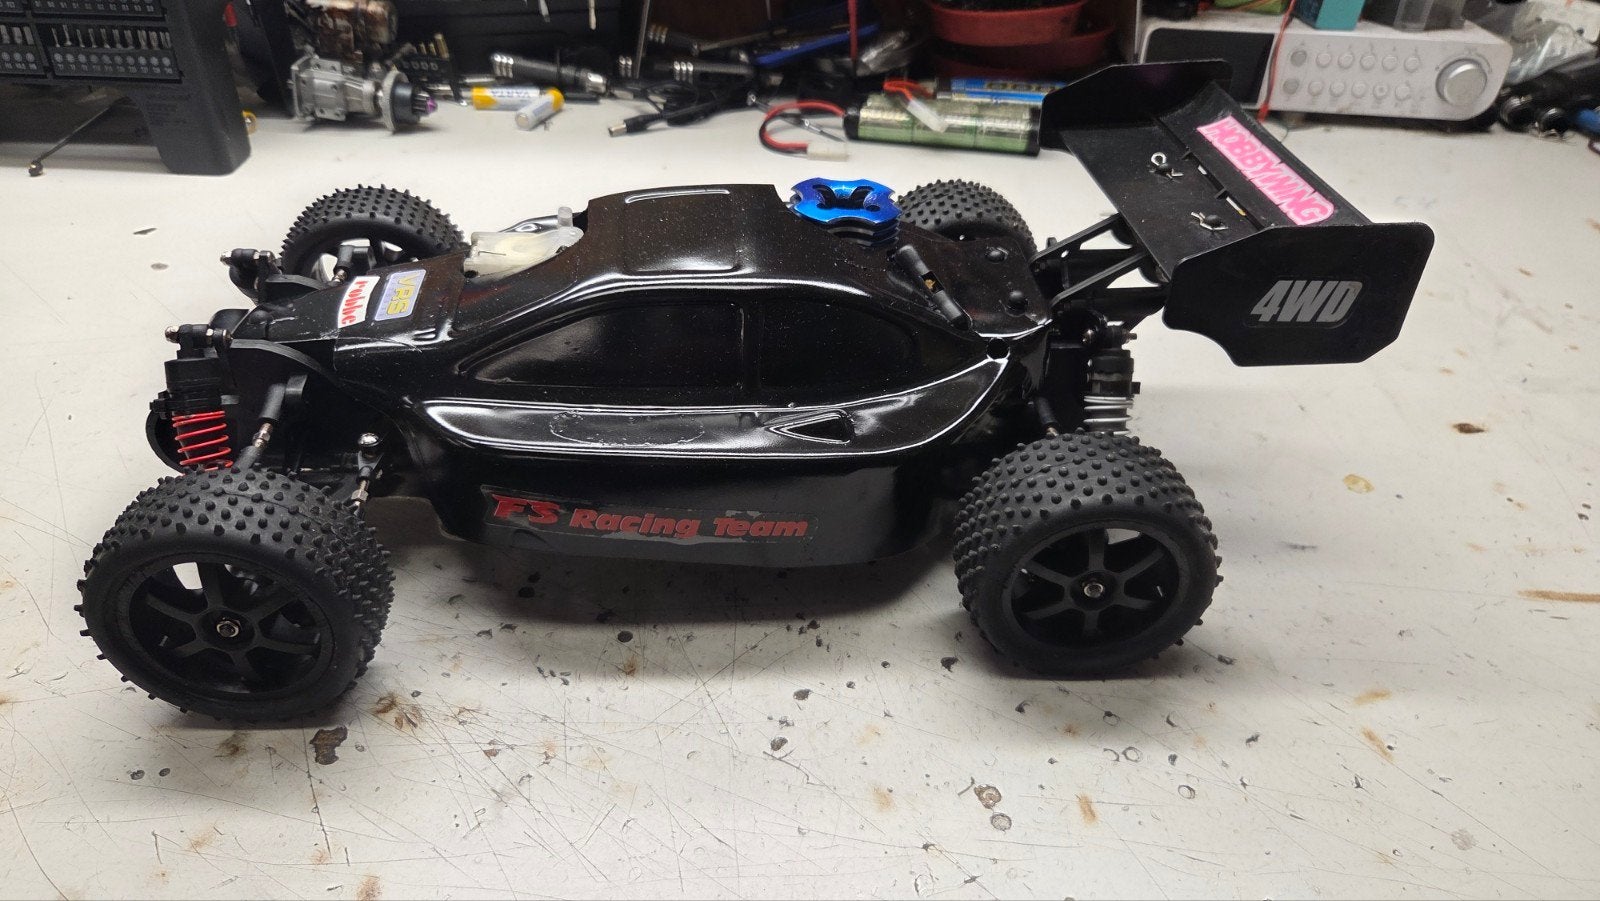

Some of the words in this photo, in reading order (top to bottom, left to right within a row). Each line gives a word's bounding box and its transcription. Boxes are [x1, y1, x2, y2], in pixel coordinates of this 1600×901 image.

[1199, 117, 1332, 224] HOBBYWING
[341, 280, 368, 325] robbe
[1250, 279, 1364, 323] 4WD
[491, 493, 561, 524] FS
[569, 508, 701, 539] Racing
[712, 516, 808, 537] Team
